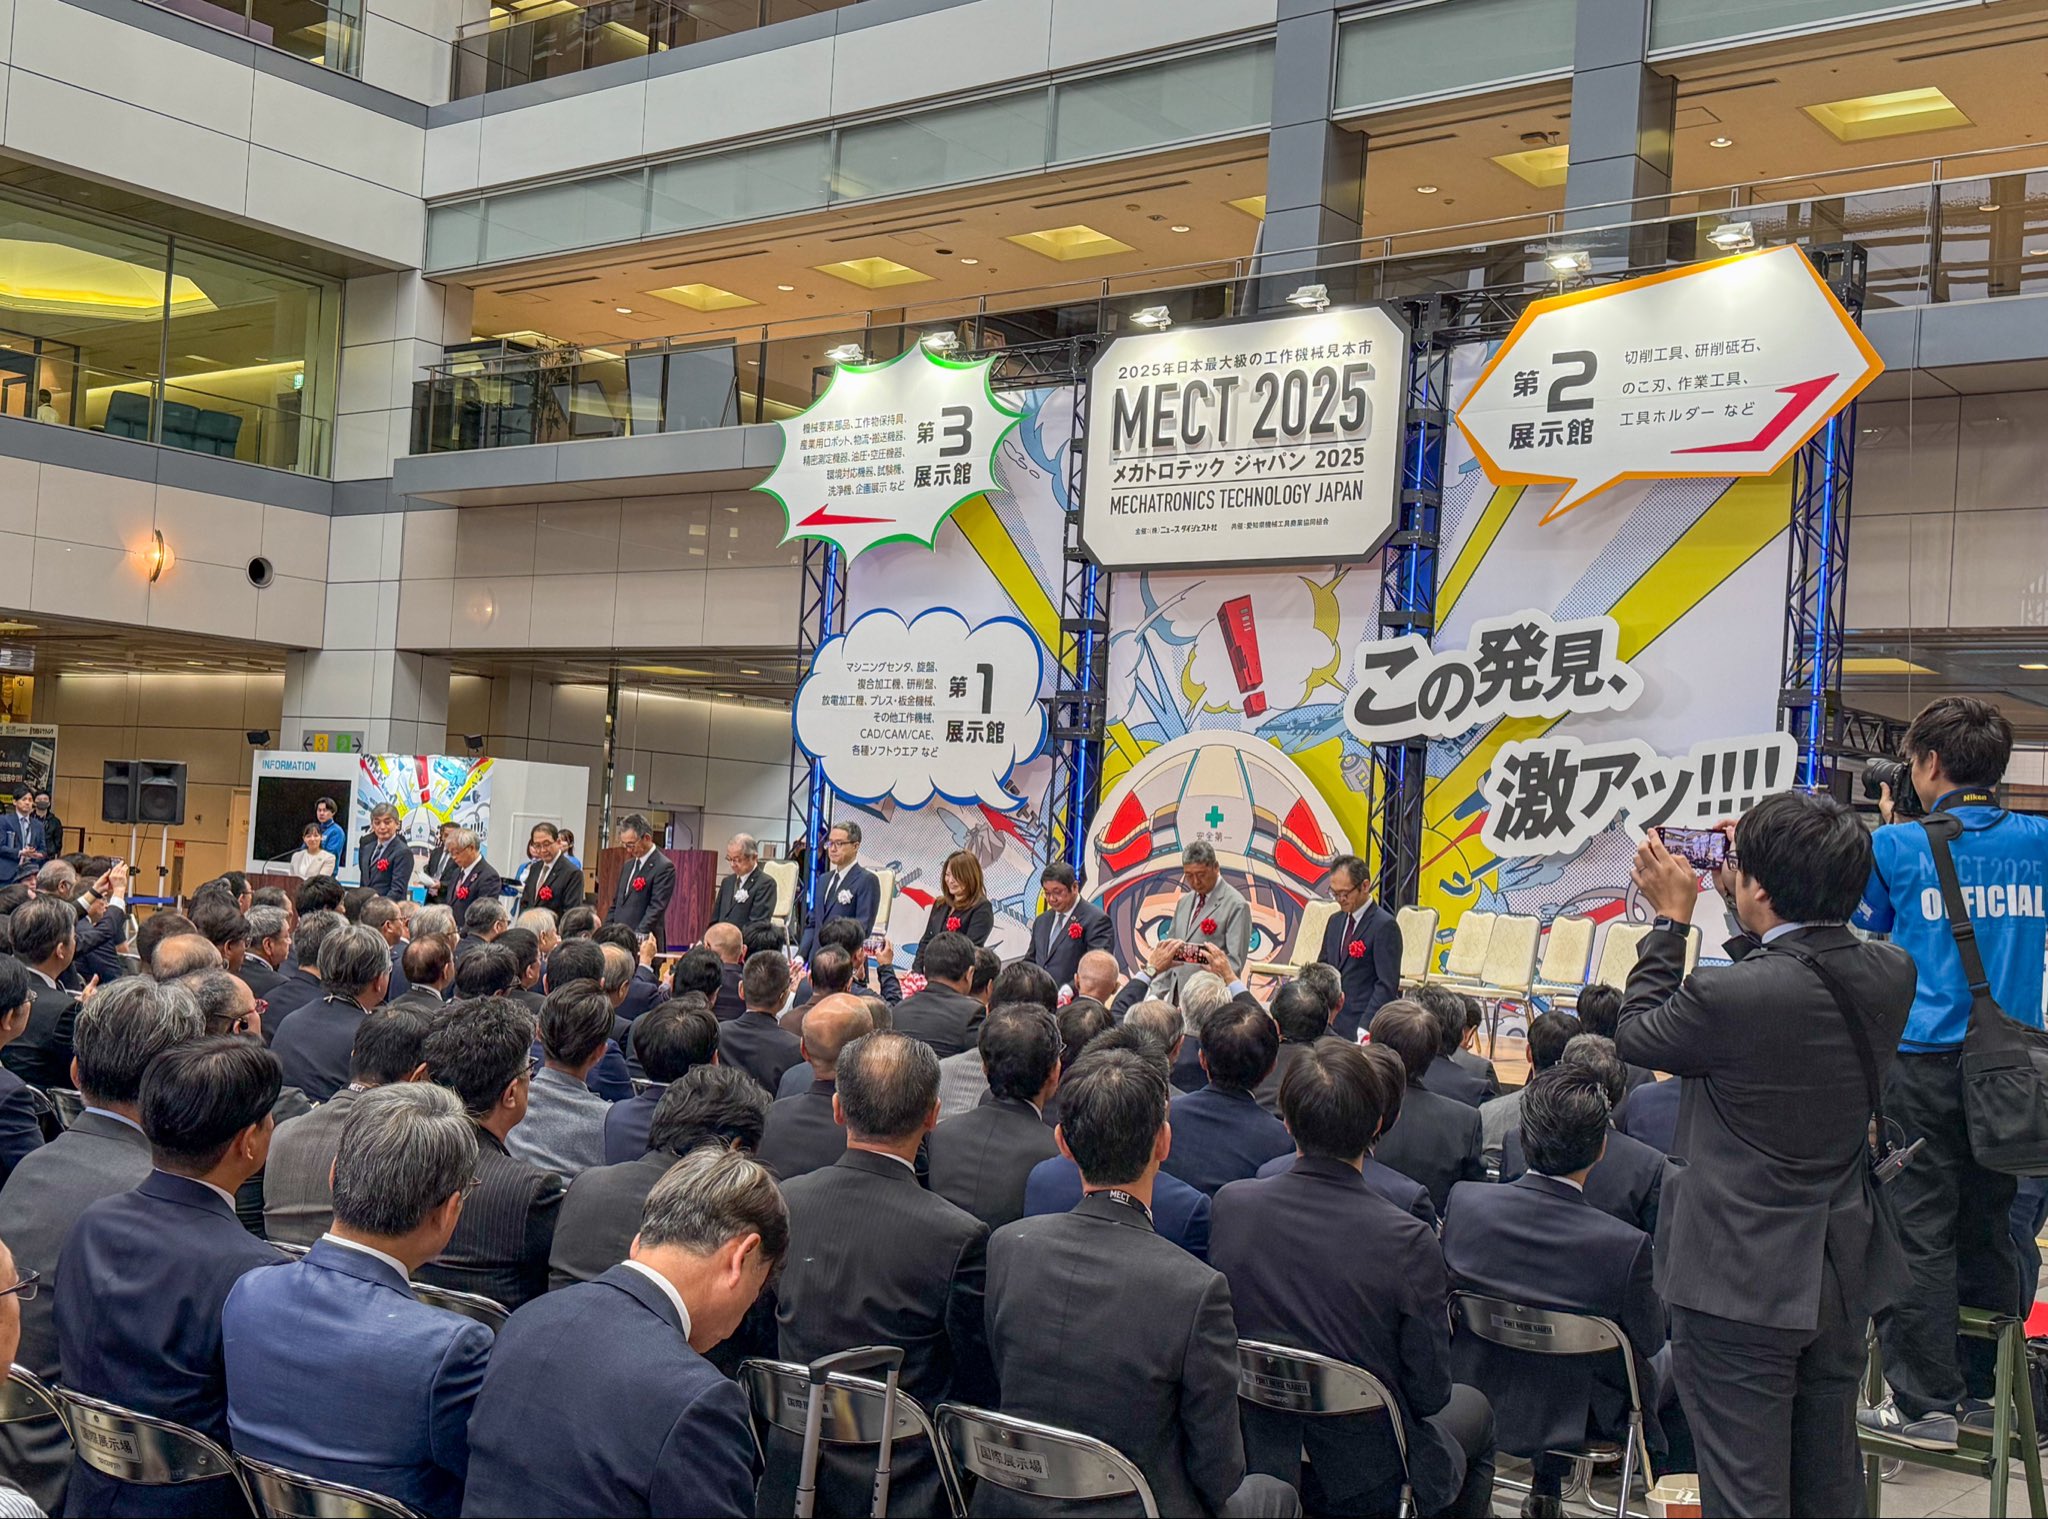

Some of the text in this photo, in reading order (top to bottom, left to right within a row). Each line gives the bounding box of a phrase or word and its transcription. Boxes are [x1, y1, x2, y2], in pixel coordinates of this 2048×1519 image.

[1118, 339, 1374, 380] 2025年日本最大級の工作機械見本市
[1625, 338, 1761, 365] 切削工具、研削砥石、
[1622, 371, 1748, 395] のこ刃、作業工具、
[1112, 362, 1369, 452] MECT 2025
[1620, 401, 1756, 426] 工具ホルダー など
[1508, 417, 1595, 450] 展示館
[914, 461, 972, 488] 展示館
[1113, 447, 1365, 484] メカトロテック ジャパン 2025
[889, 480, 906, 492] など
[1110, 480, 1363, 515] MECHATRONICS TECHNOLOGY JAPAN
[846, 661, 938, 673] マシニングセンタ、旋盤、
[1354, 621, 1630, 726] この発見、
[857, 678, 937, 690] 複合加工機、研削盤、
[873, 712, 935, 724] その他工作機械、
[860, 728, 934, 741] CAD/CAM/CAE、
[945, 720, 1005, 744] 展示館
[921, 746, 939, 758] など
[262, 759, 317, 772] INFORMATION
[1963, 793, 1988, 802] Nikon
[1919, 852, 2043, 884] MCT 2025
[1920, 884, 2046, 921] OFICIAL
[1109, 1190, 1131, 1203] MECT
